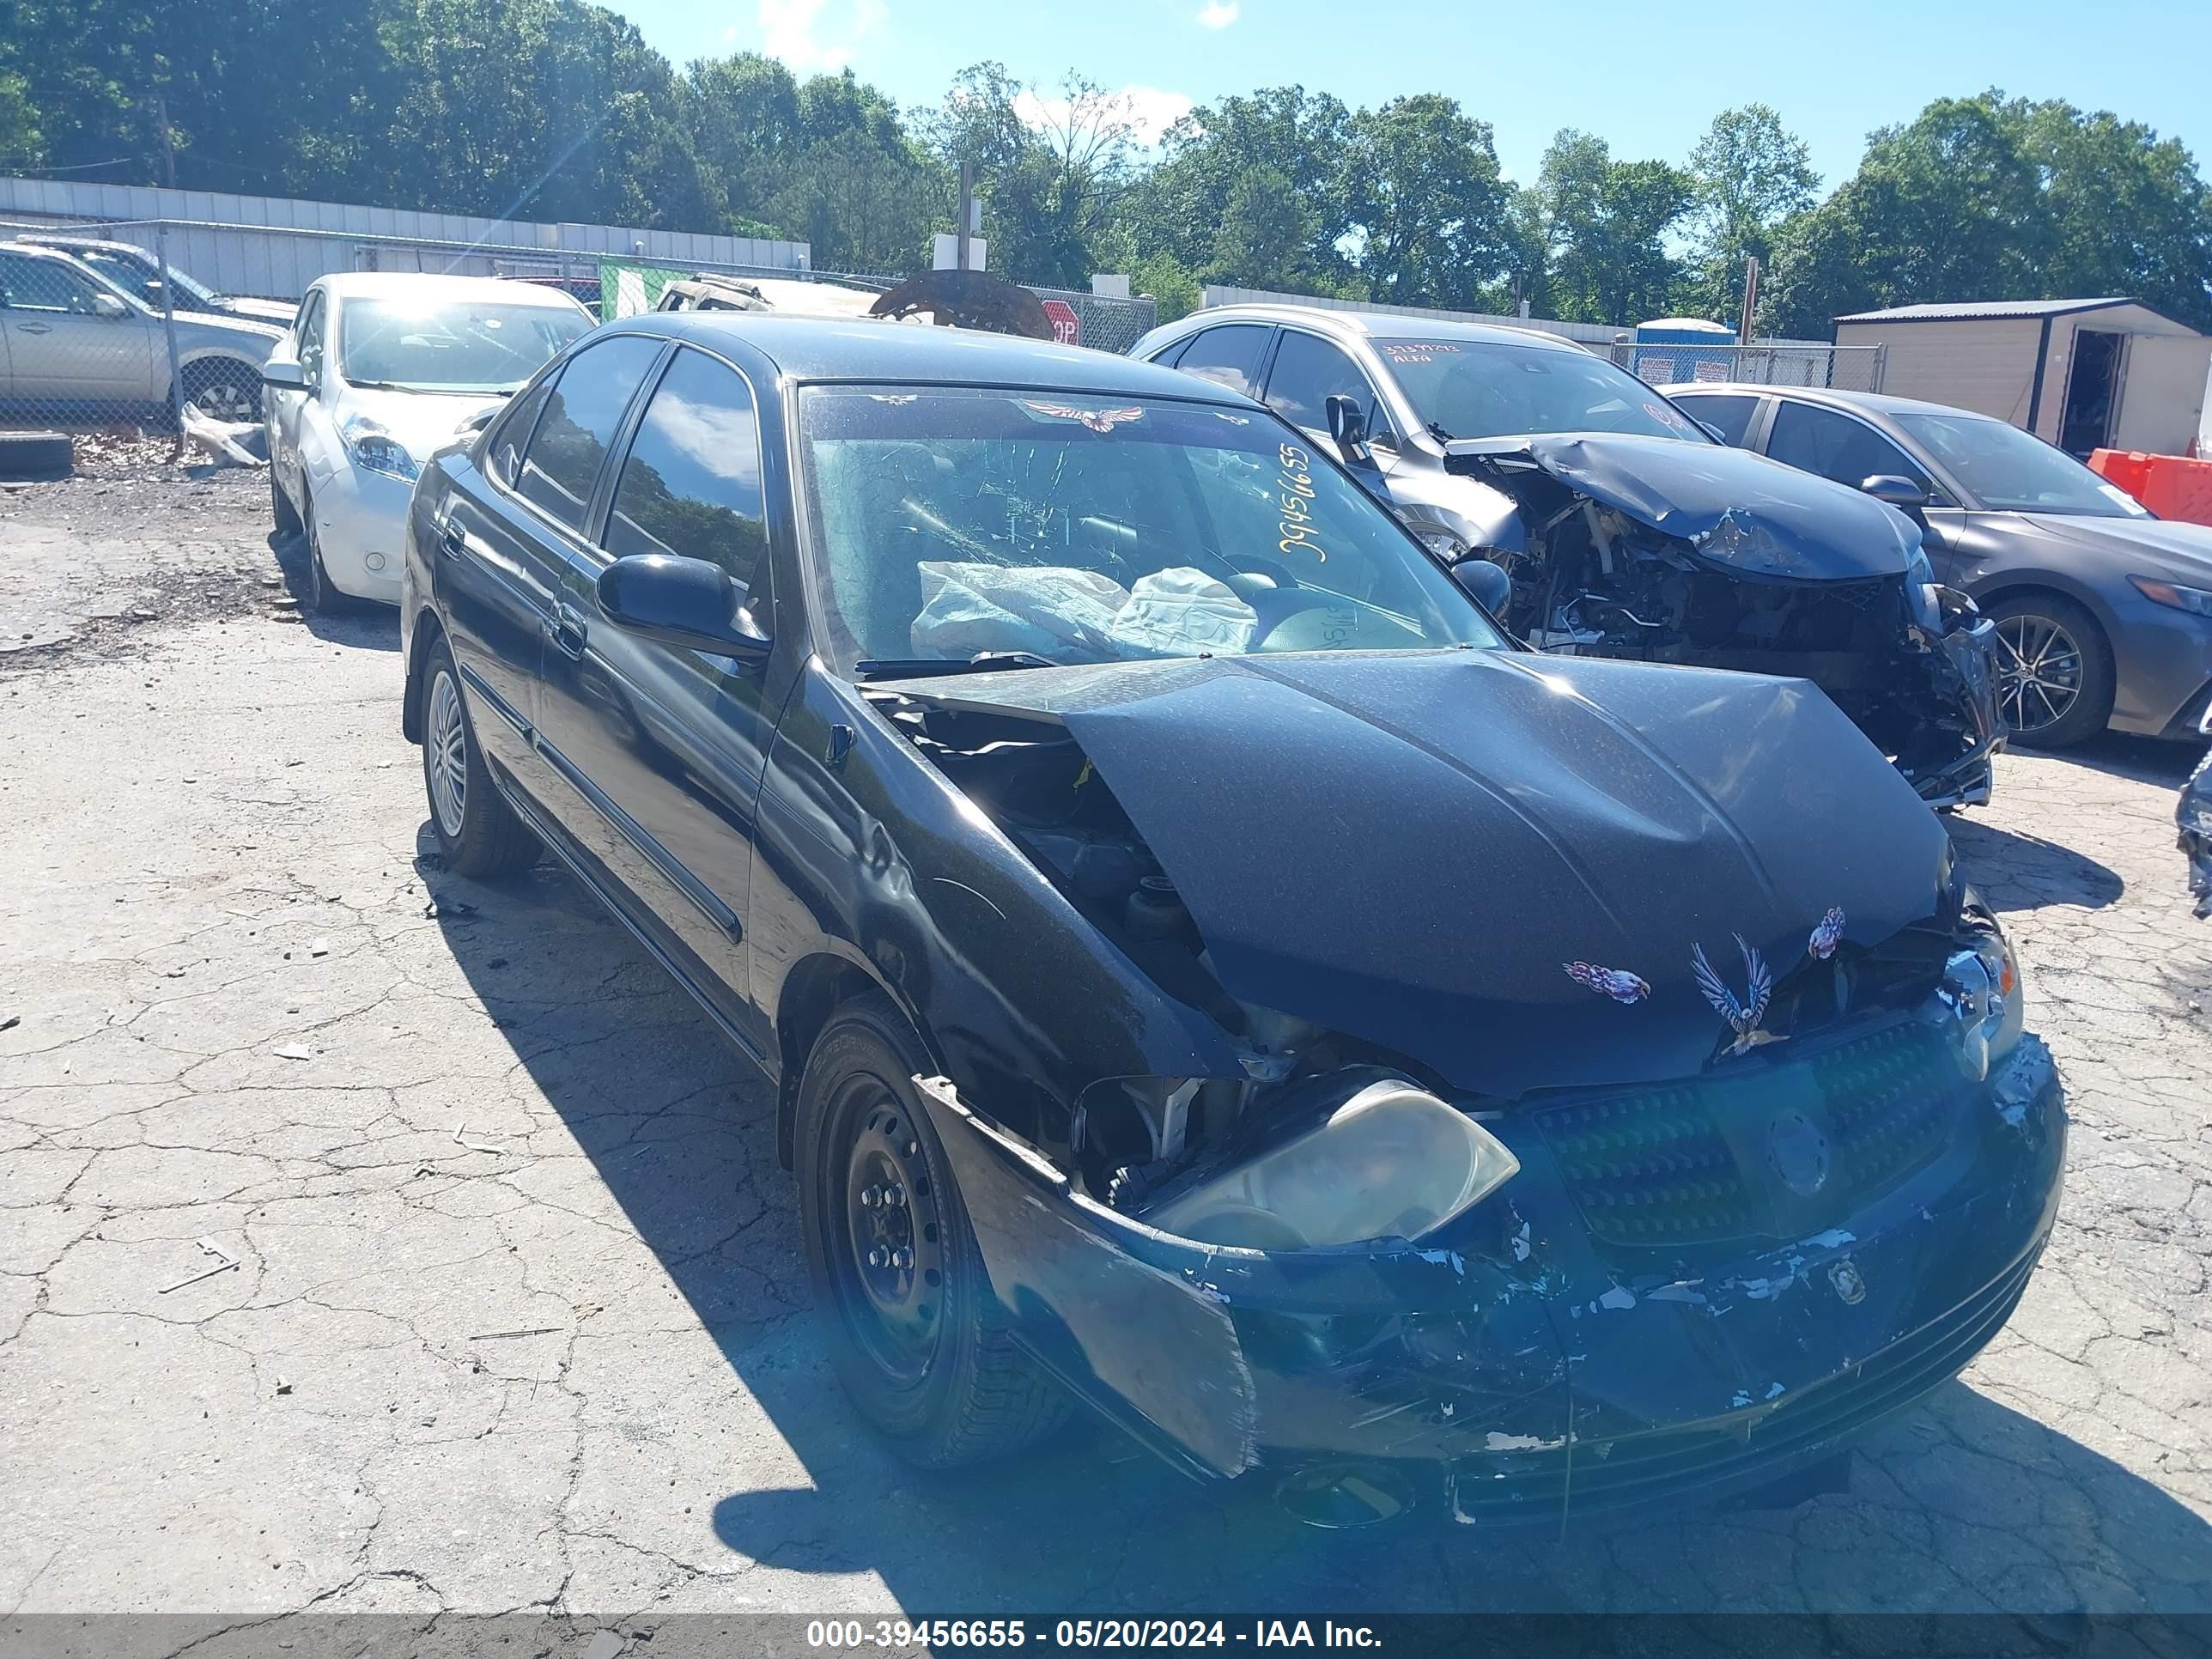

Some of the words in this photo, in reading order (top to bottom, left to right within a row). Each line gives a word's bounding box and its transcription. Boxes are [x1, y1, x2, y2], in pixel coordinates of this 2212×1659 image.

[1054, 320, 1076, 343] OP
[1394, 355, 1431, 364] ALFA
[1277, 442, 1327, 563] 39456655
